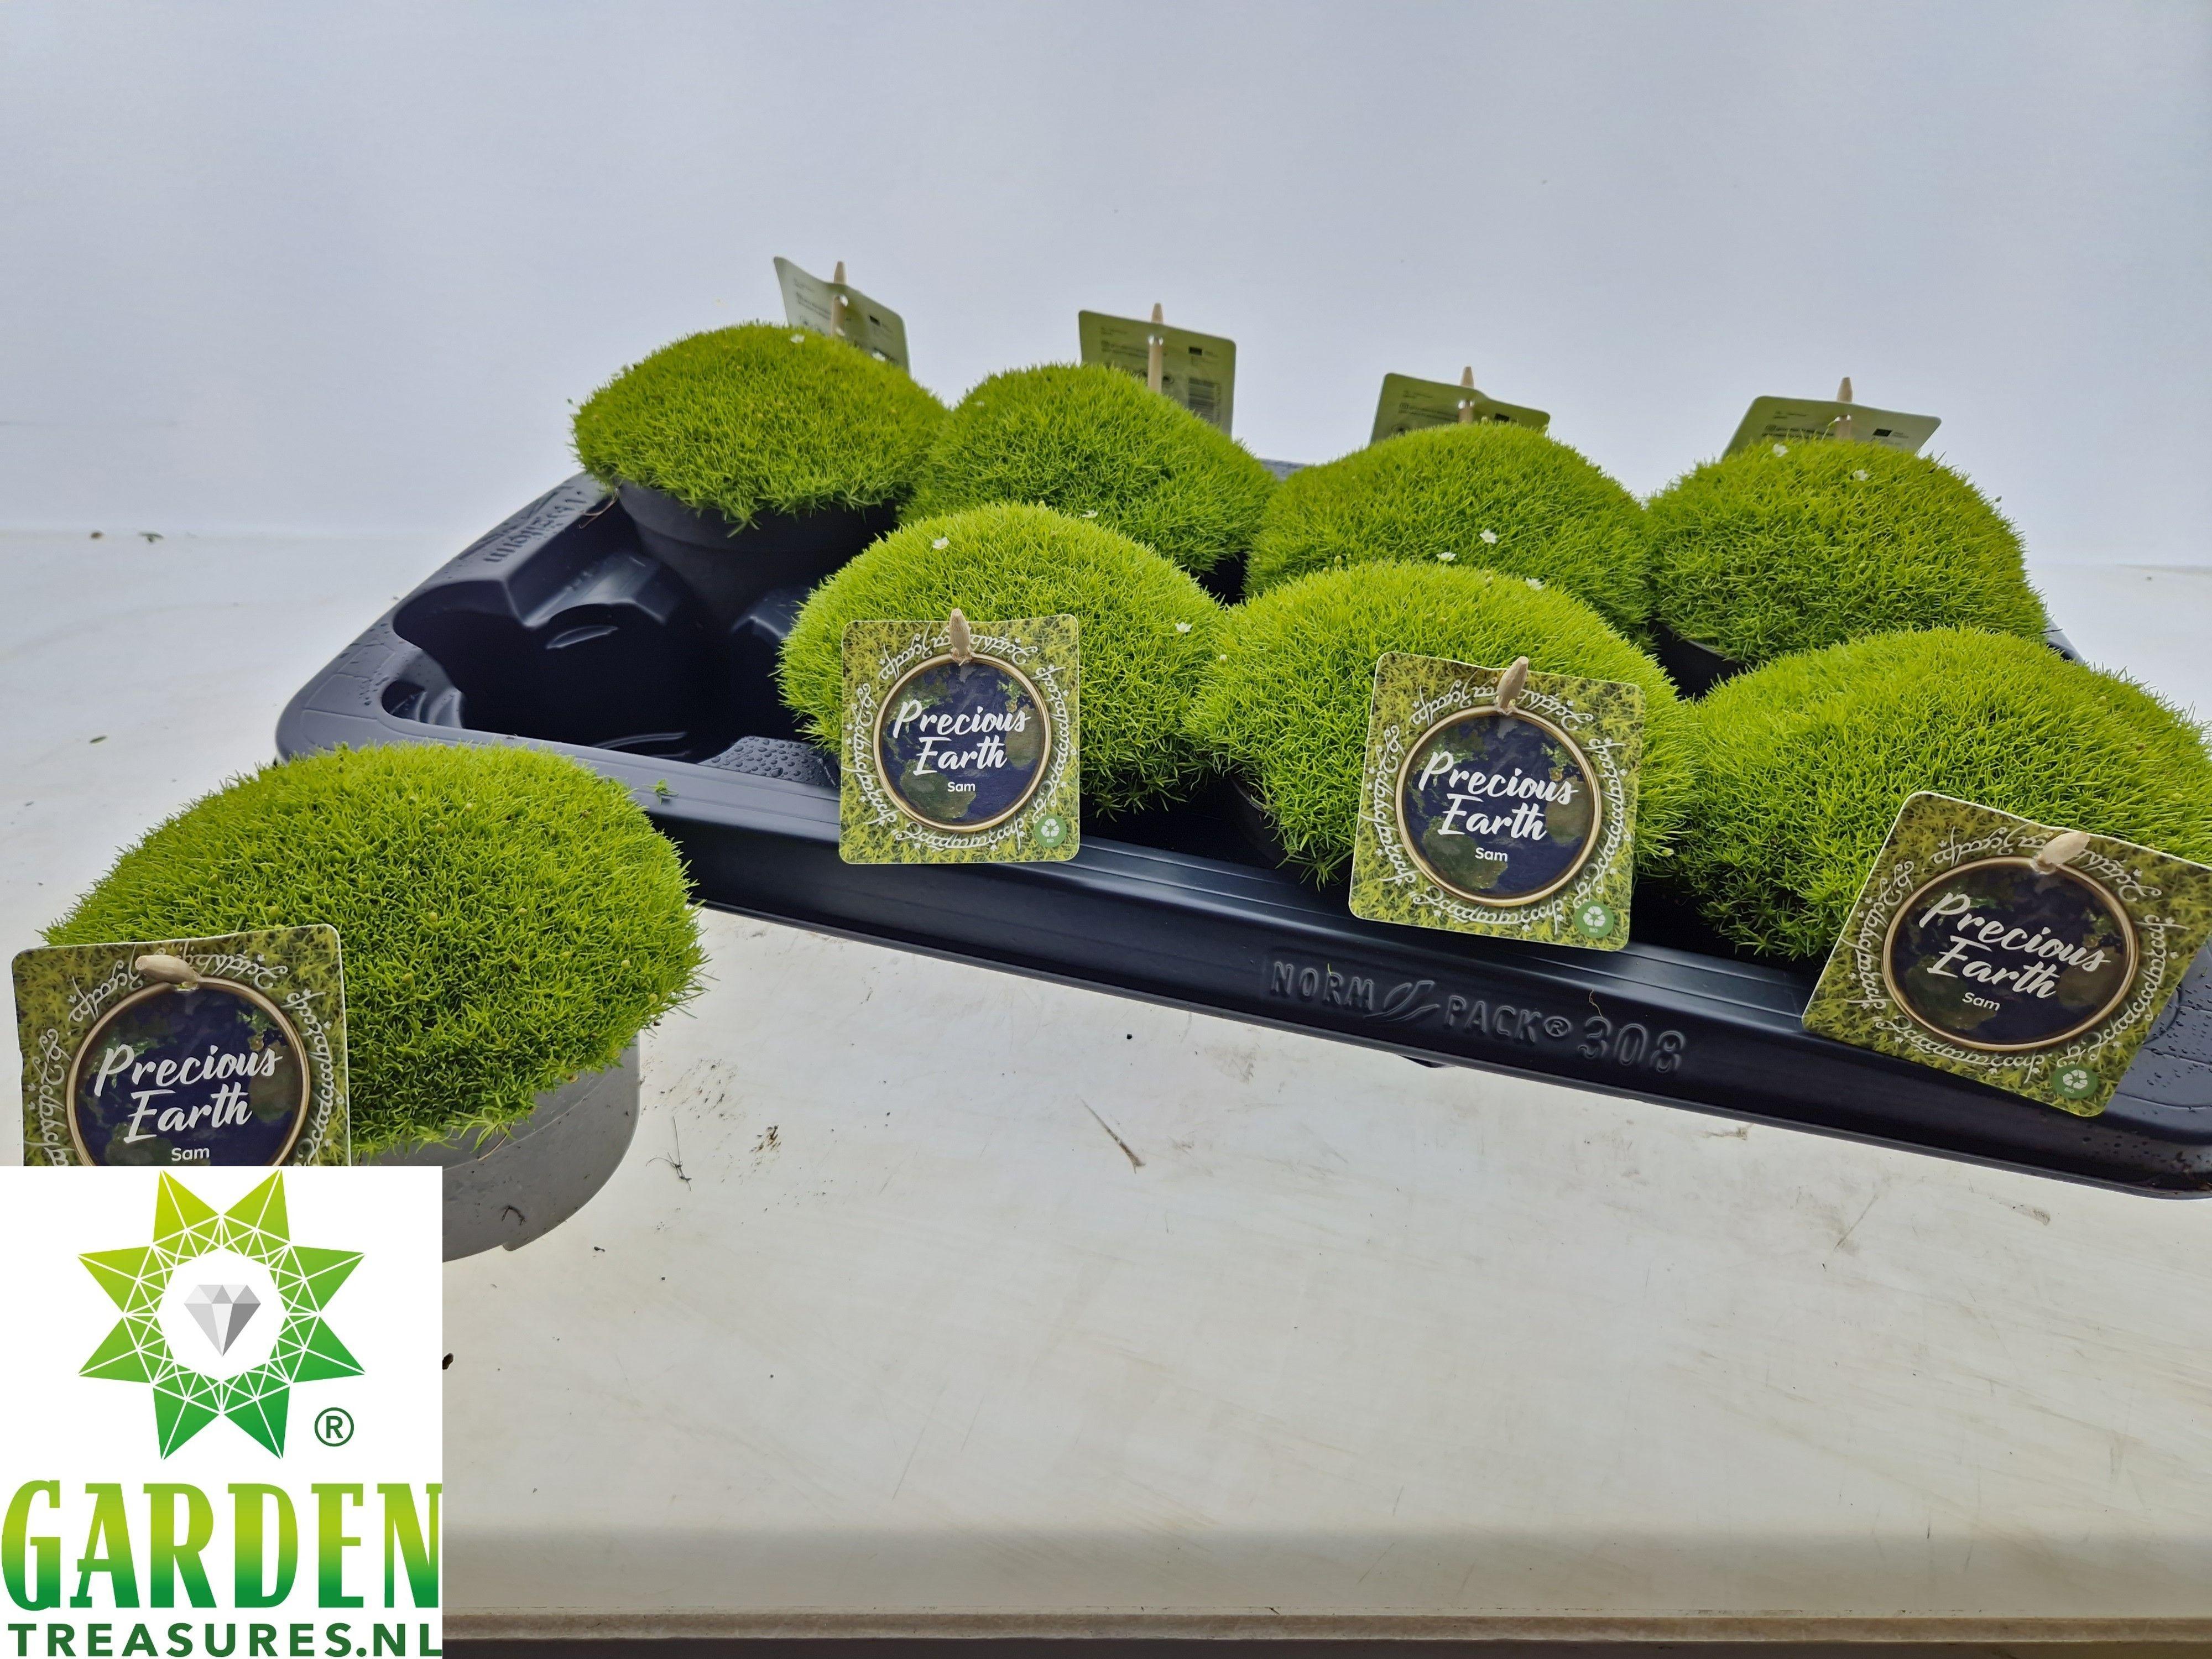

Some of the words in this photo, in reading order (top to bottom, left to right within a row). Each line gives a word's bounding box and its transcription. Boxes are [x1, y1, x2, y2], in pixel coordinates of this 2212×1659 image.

[893, 699, 1031, 739] Precious
[914, 735, 1007, 776] Earth
[1418, 751, 1579, 805] Precious
[947, 782, 975, 792] Sam
[1437, 793, 1547, 841] Earth
[1475, 847, 1509, 863] Sam
[1919, 891, 2111, 972] Precious
[1927, 935, 2057, 999] Earth
[1270, 961, 1374, 1011] NORM
[1577, 1015, 1686, 1073] 308
[1962, 992, 2001, 1011] Sam
[93, 1044, 283, 1097] Precious
[123, 1081, 253, 1144] Earth
[171, 1147, 210, 1161] Sam
